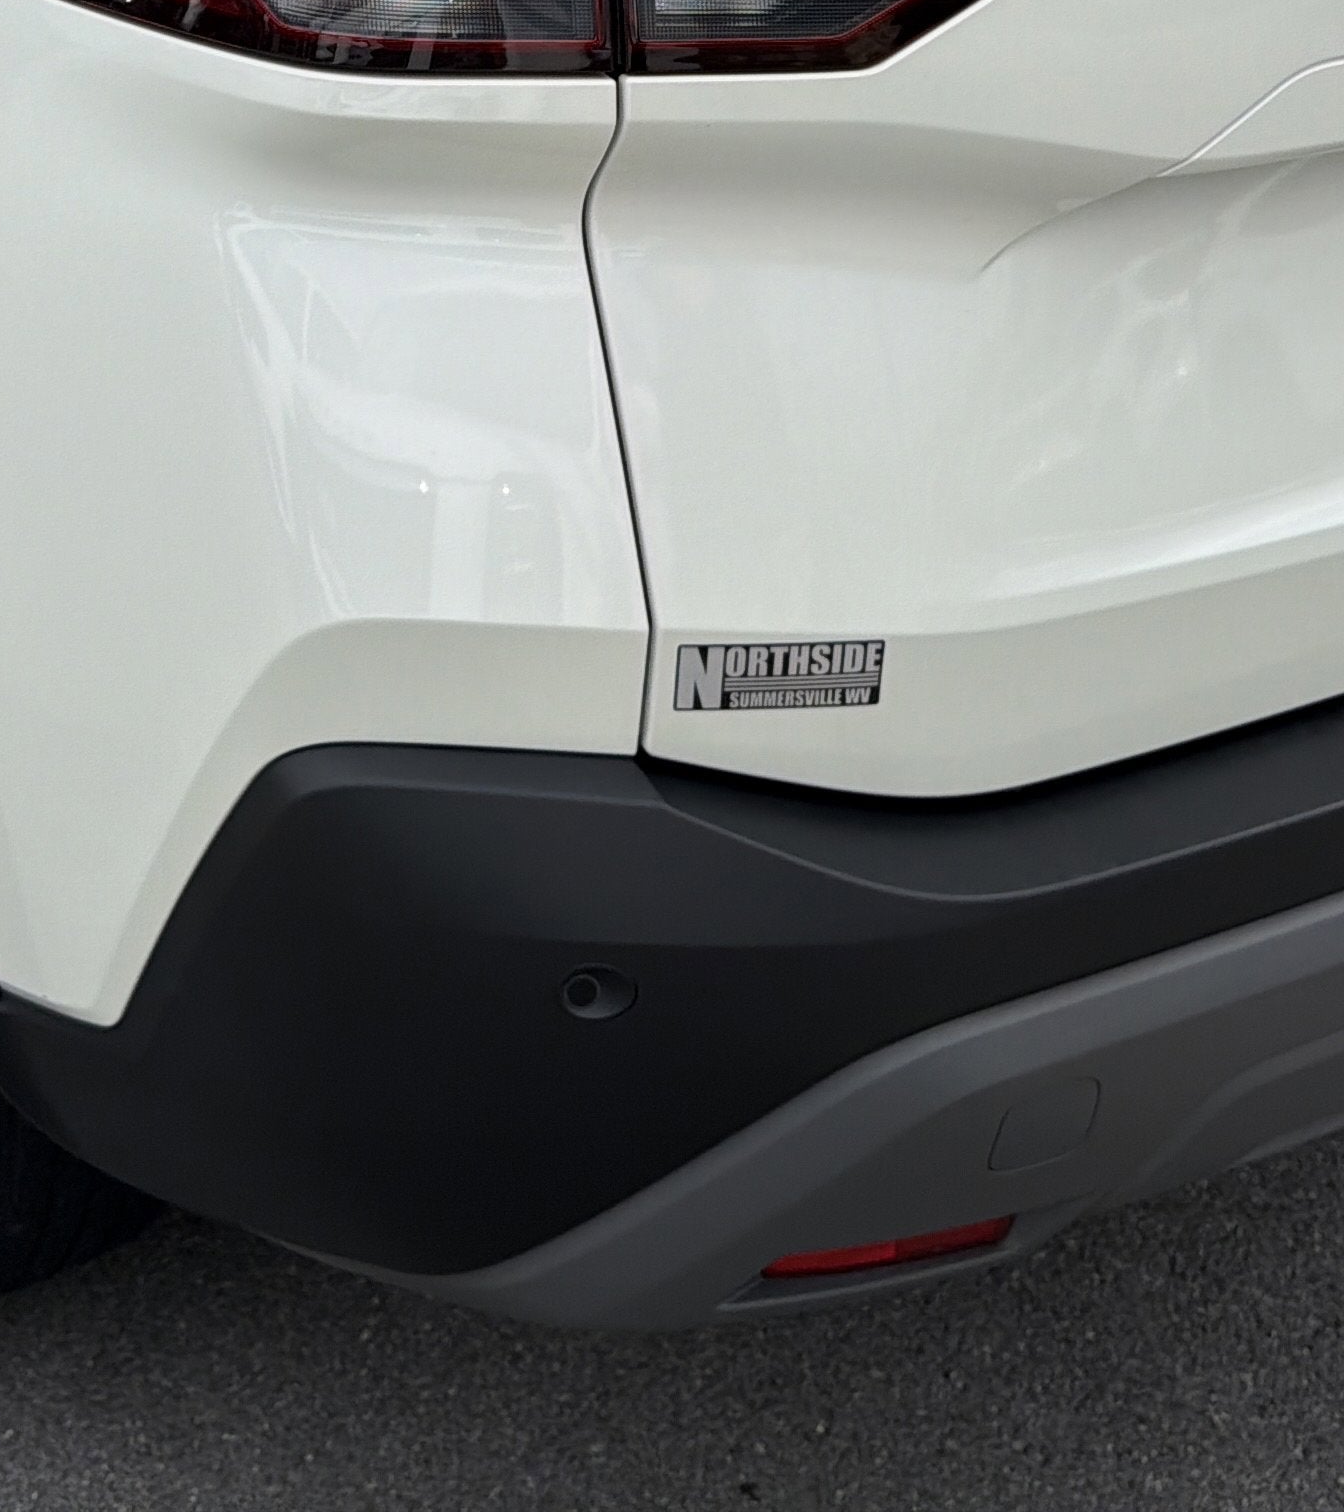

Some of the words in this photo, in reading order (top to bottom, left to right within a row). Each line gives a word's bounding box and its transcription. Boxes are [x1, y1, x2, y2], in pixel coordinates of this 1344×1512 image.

[675, 642, 883, 710] NORTHSIDE
[728, 689, 842, 708] SUMMERSVILLE
[844, 686, 871, 704] WV
